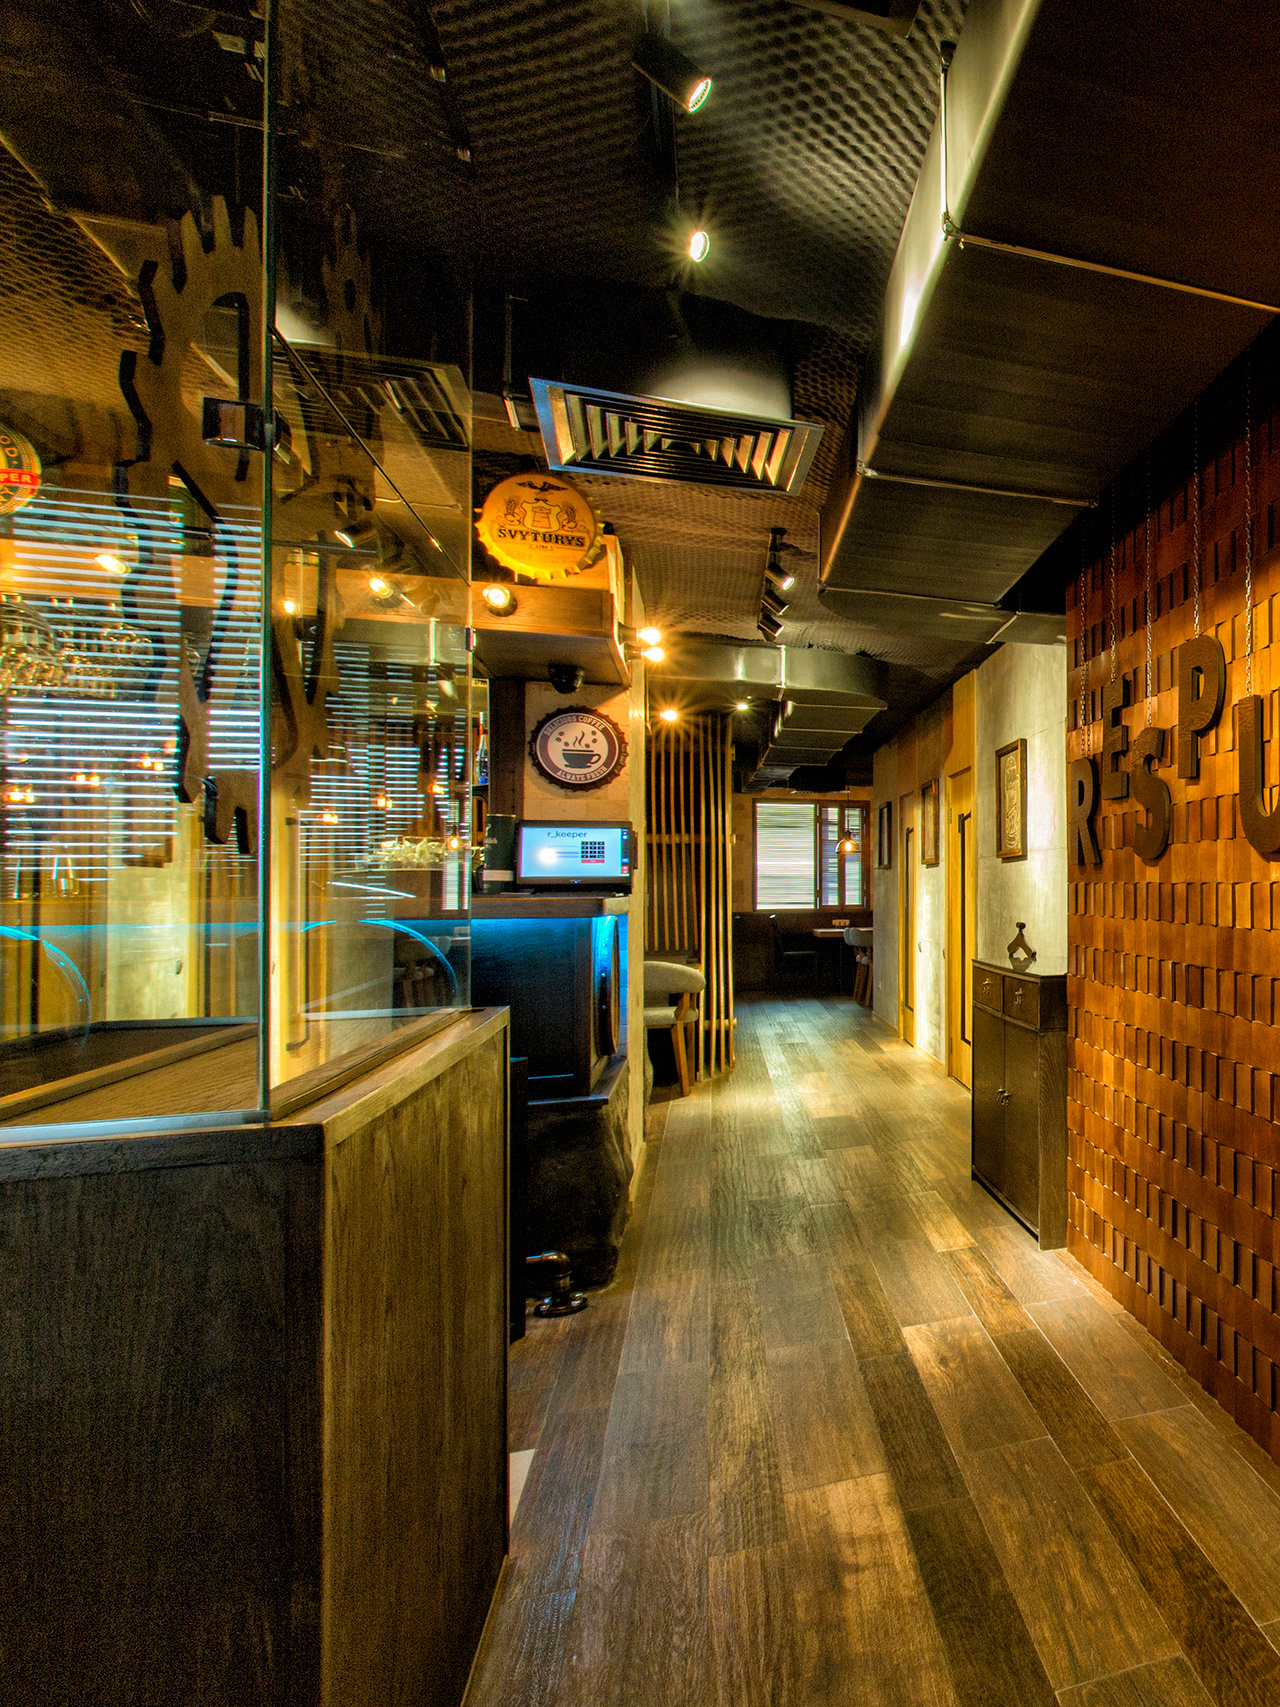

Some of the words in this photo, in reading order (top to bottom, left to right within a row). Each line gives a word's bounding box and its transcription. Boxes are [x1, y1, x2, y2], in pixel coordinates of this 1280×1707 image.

[498, 525, 585, 547] ŠVYTURYS
[544, 715, 577, 736] DELICIOUS
[578, 715, 606, 731] COFFEE
[556, 770, 586, 781] ALWAYS
[586, 765, 608, 780] FRESH
[547, 830, 588, 839] r_keeper
